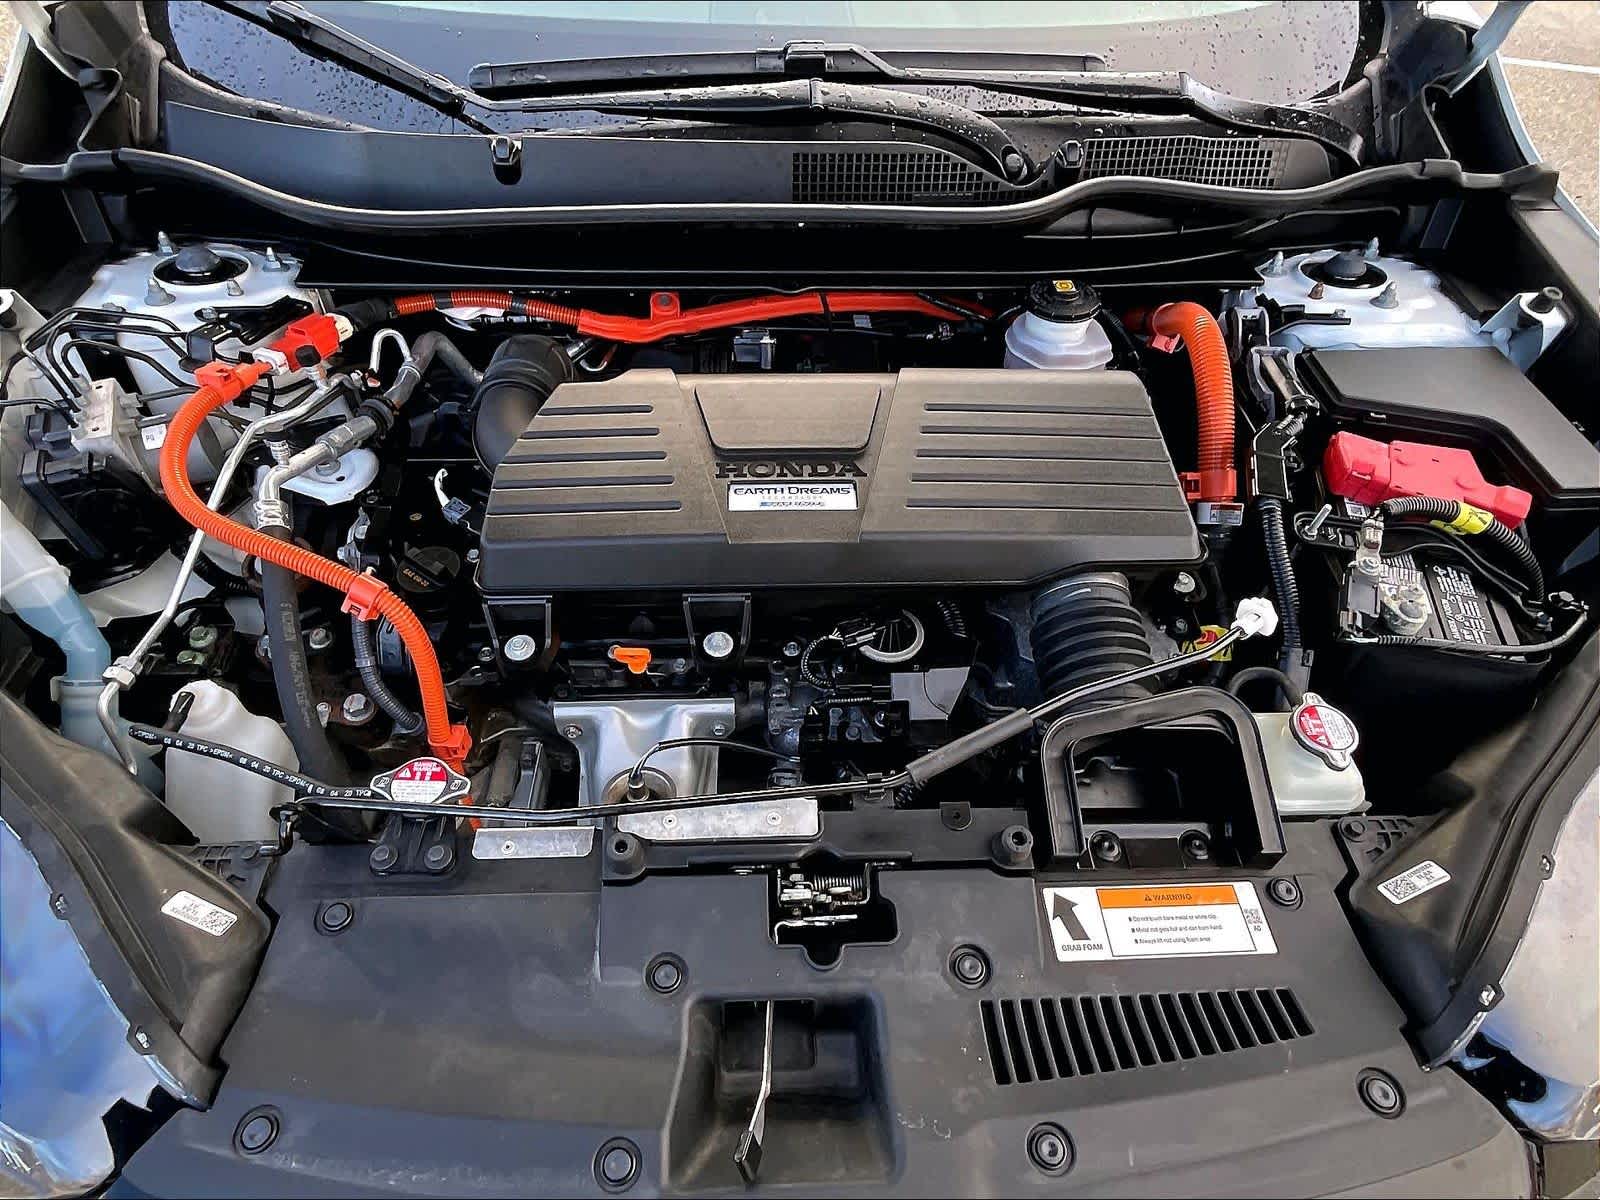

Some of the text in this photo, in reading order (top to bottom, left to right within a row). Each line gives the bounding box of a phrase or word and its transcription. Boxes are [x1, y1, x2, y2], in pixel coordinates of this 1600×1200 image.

[715, 461, 868, 479] HONDA
[734, 486, 851, 495] EARTH DREAMS
[1153, 893, 1192, 901] WARNING
[1061, 943, 1104, 952] GRAB FOAM
